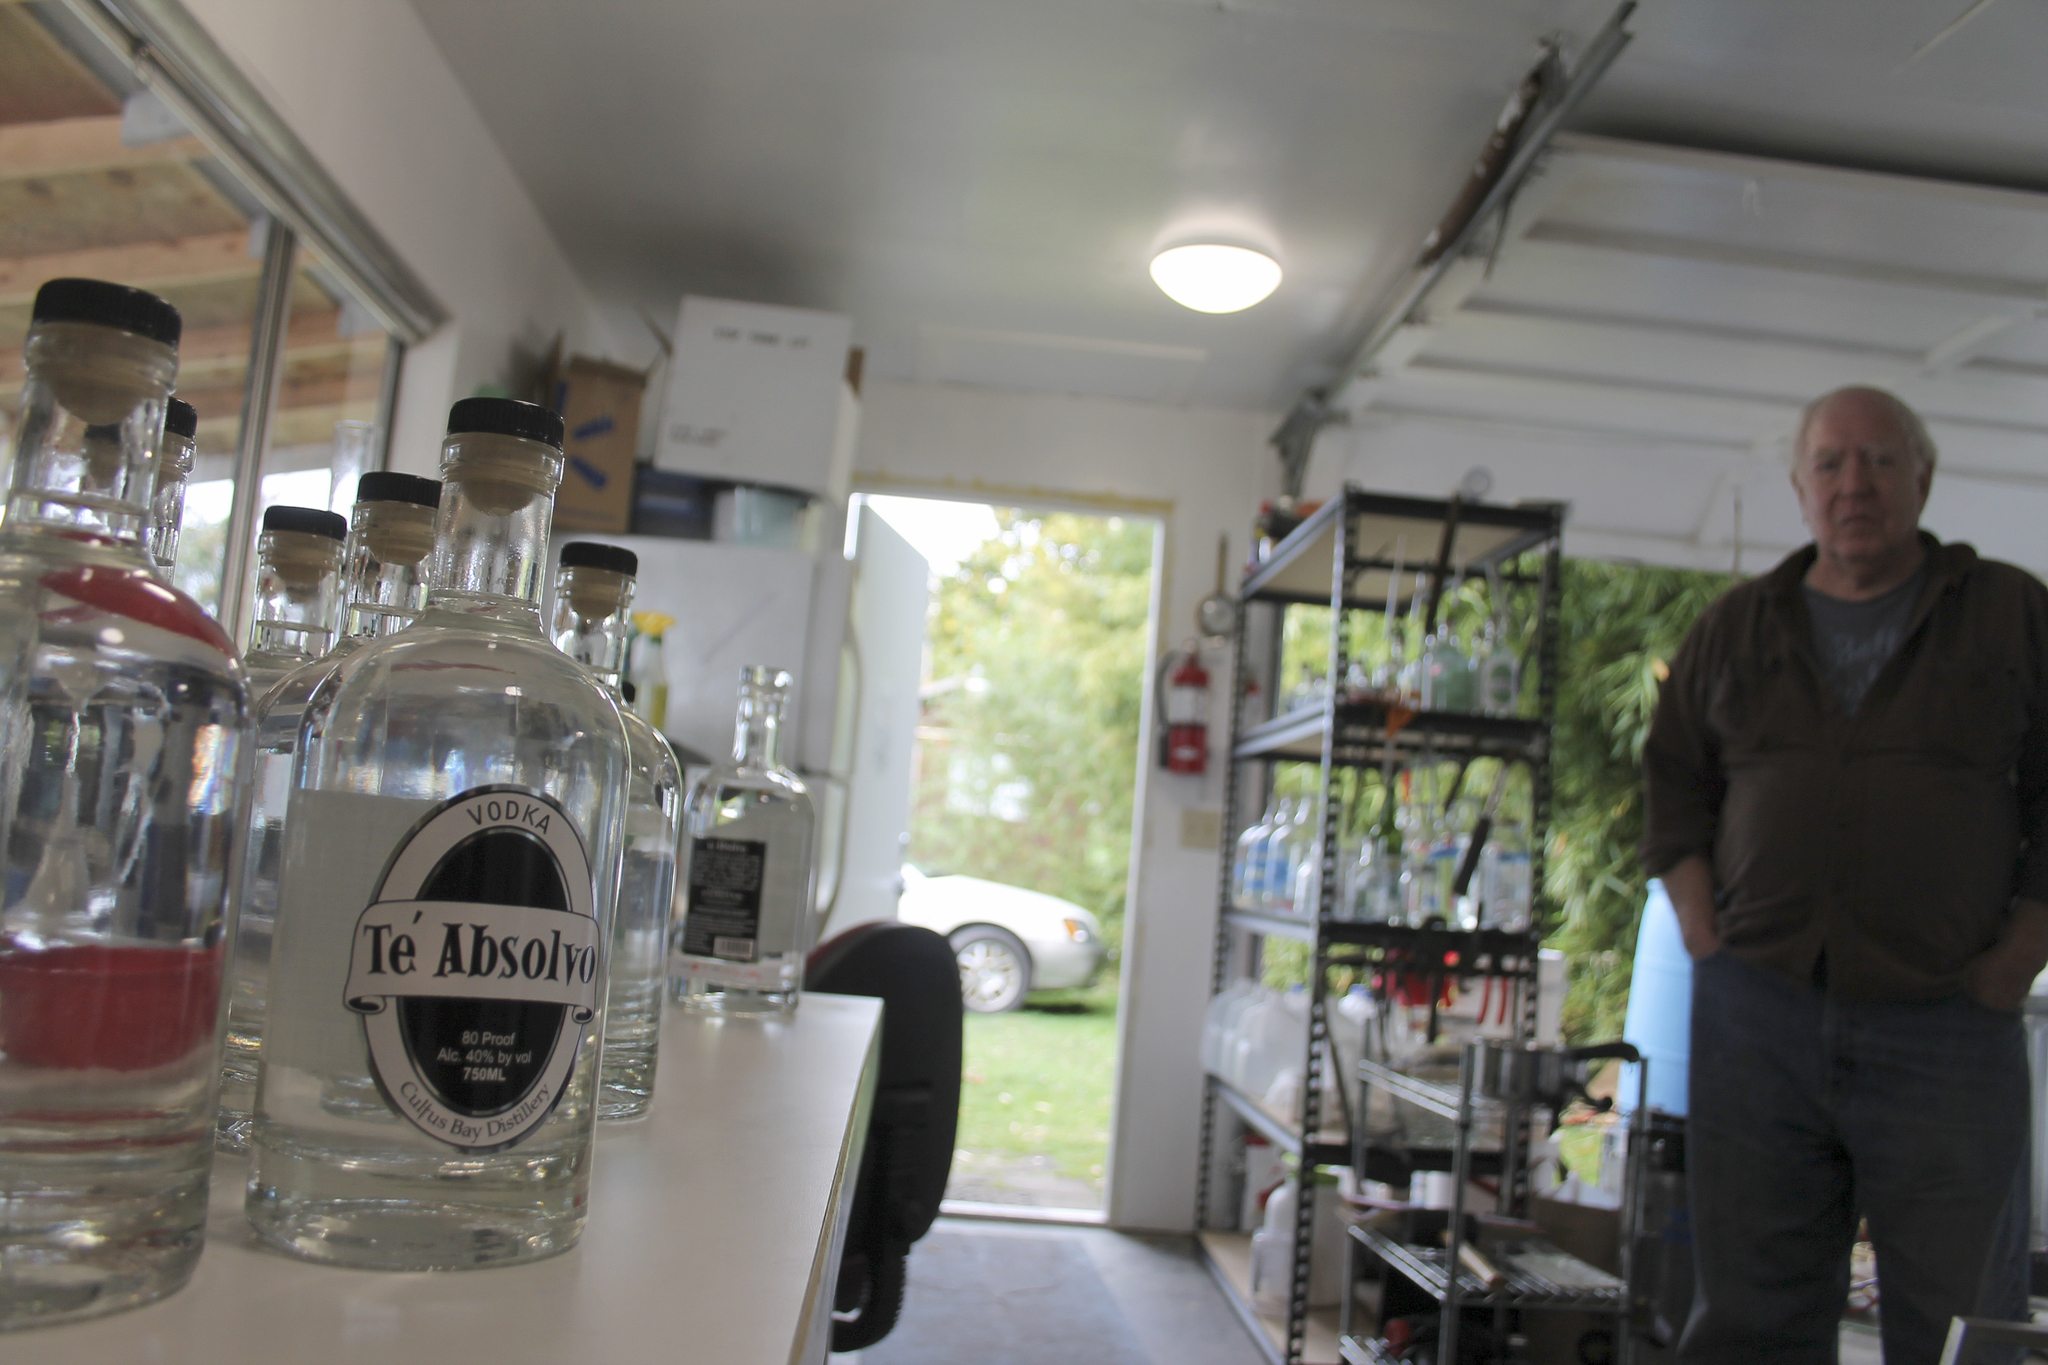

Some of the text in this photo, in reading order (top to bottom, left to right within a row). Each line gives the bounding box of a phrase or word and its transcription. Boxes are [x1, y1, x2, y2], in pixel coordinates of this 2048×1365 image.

[467, 800, 551, 835] VODKA
[432, 922, 596, 987] Absolvo
[462, 1030, 516, 1046] 80 Proof
[437, 1047, 532, 1067] Alc. 40% by vol
[463, 1066, 507, 1082] 750ML
[401, 1081, 550, 1144] Cultus Bay Distillery
